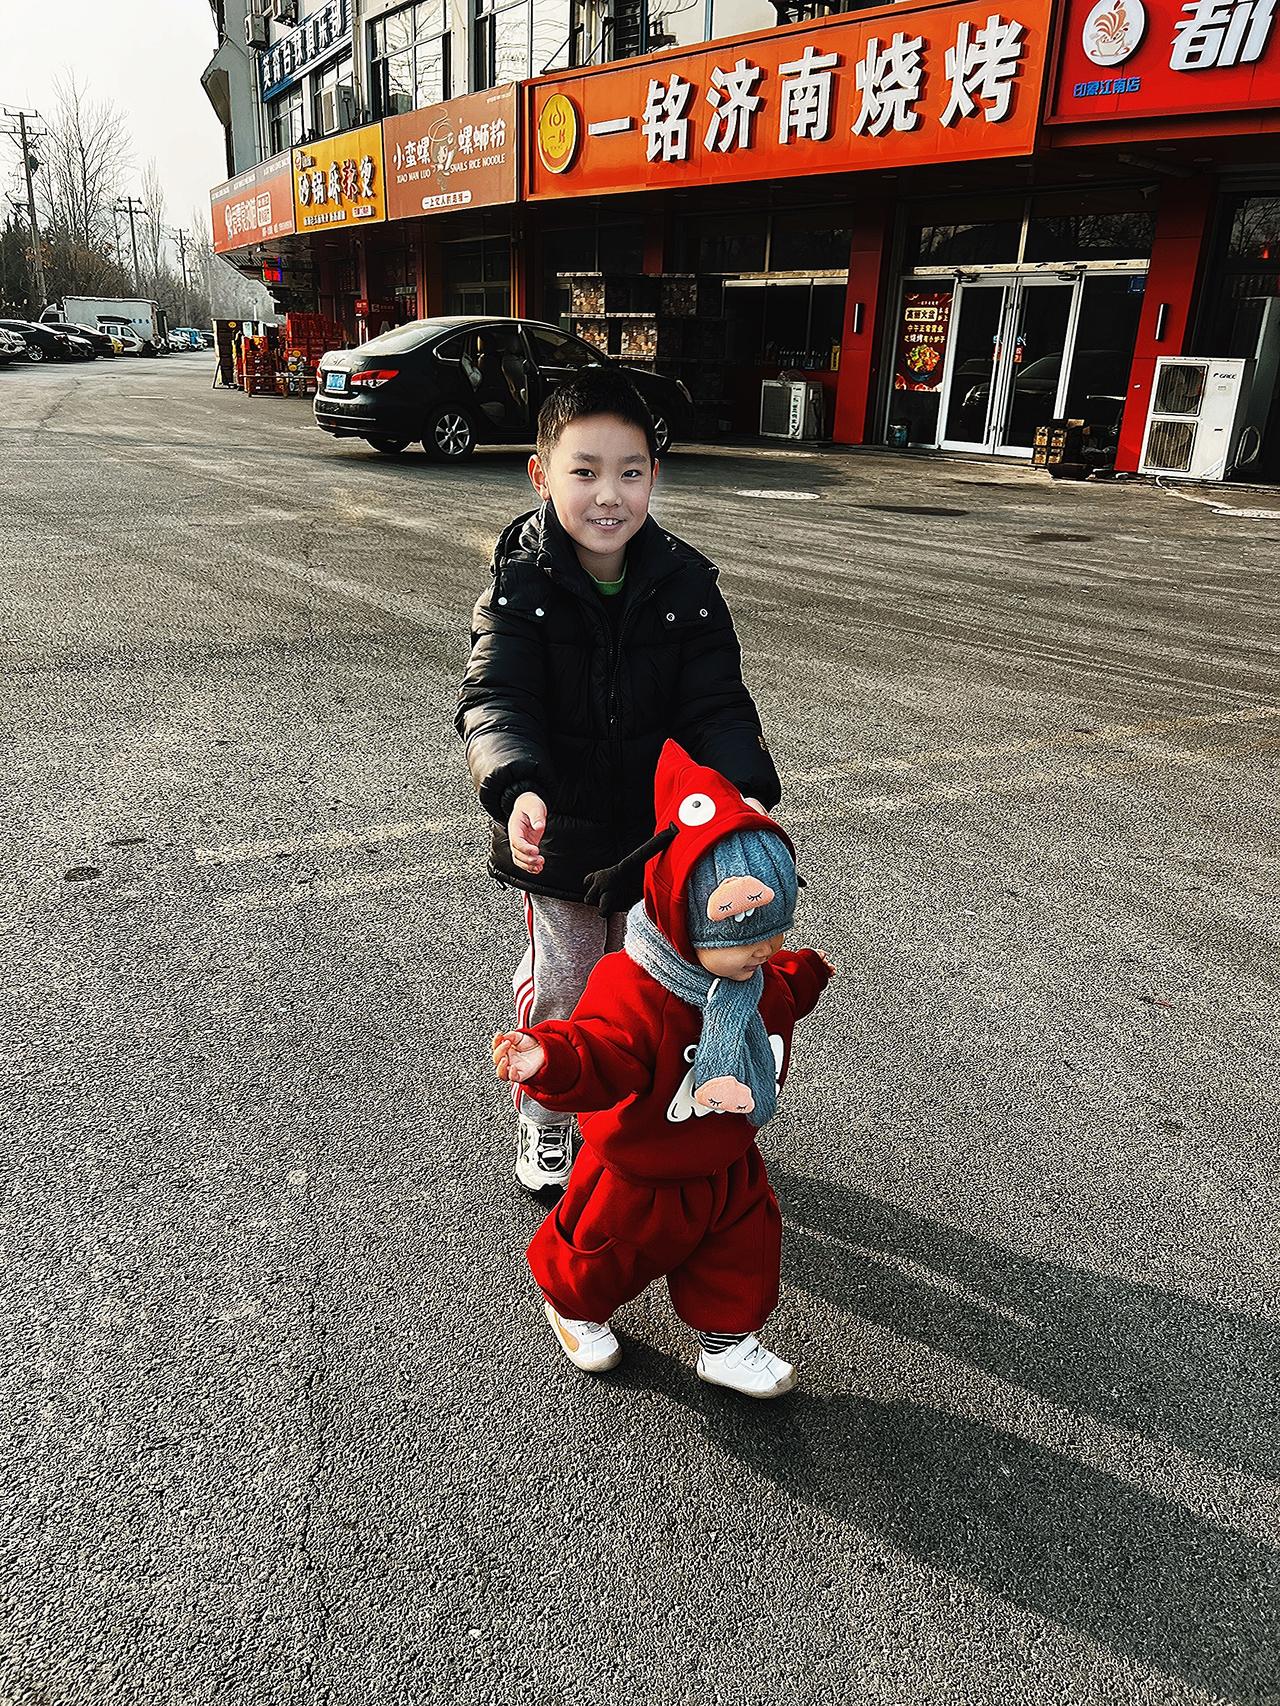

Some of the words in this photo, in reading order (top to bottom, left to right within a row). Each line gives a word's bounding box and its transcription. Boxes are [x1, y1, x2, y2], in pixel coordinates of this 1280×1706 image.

[1169, 0, 1275, 71] 都
[587, 14, 1024, 162] 一铭济南烧烤
[393, 136, 431, 170] 小蛮螺
[458, 118, 506, 155] 螺蛳粉
